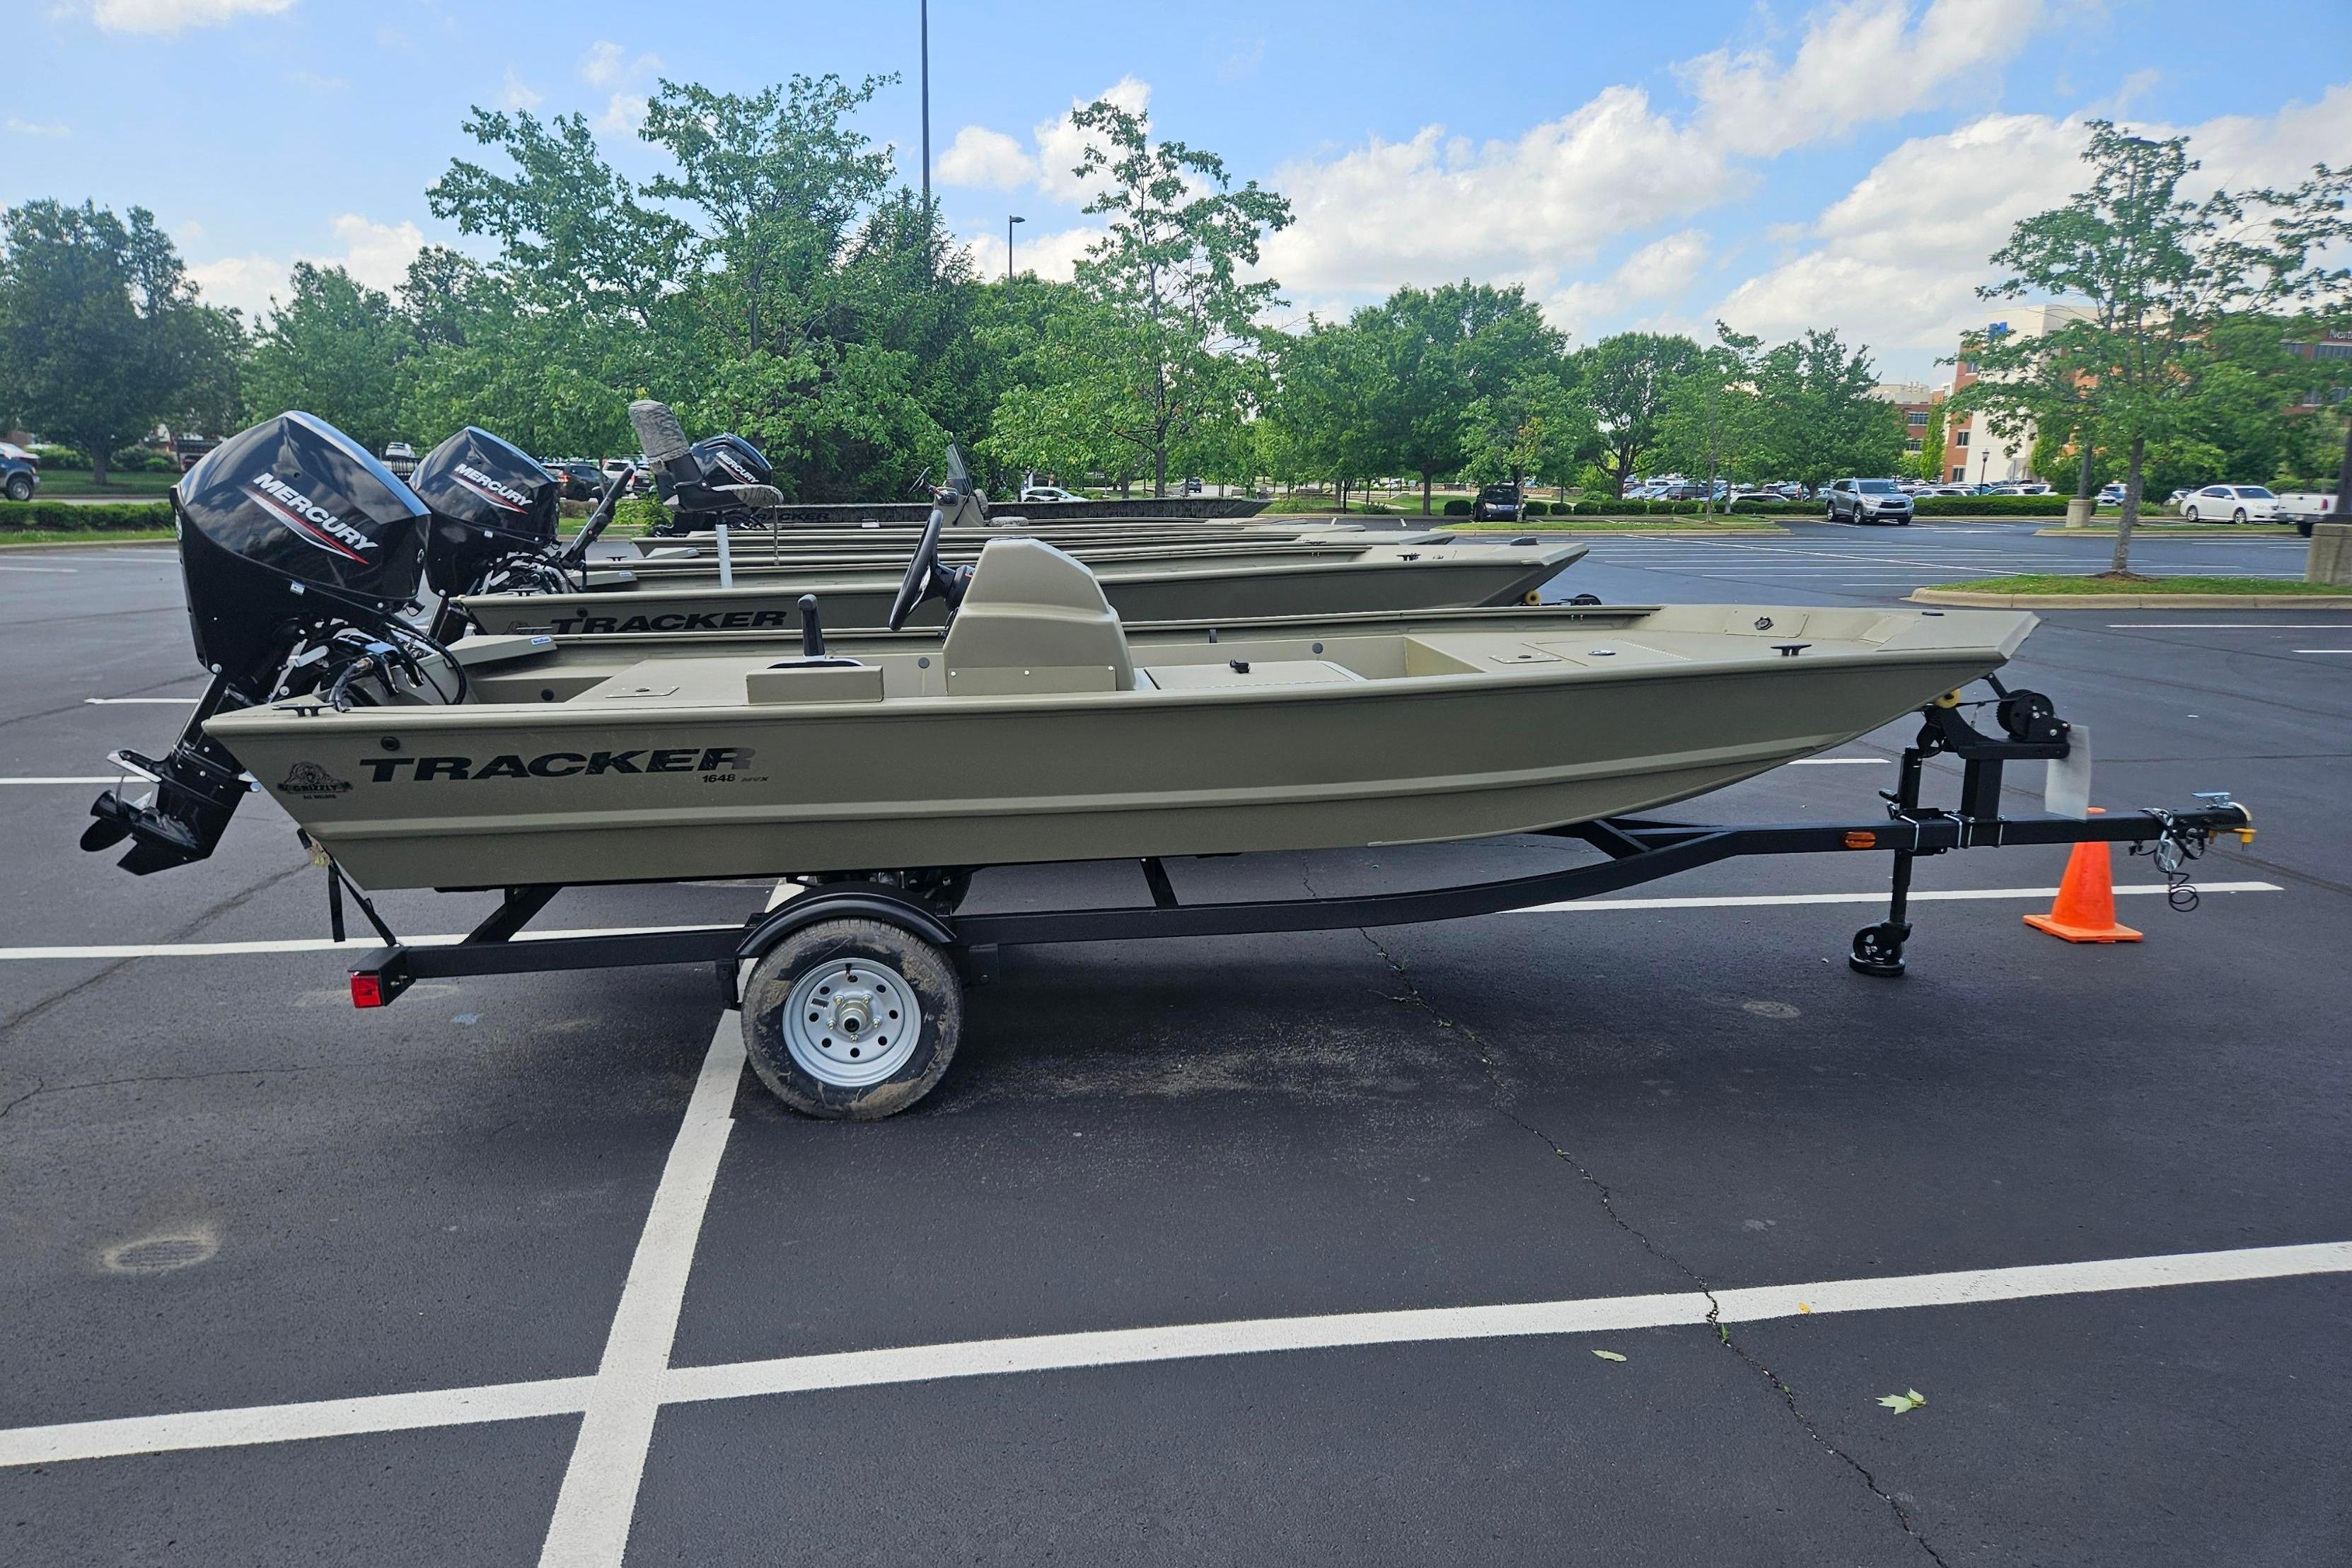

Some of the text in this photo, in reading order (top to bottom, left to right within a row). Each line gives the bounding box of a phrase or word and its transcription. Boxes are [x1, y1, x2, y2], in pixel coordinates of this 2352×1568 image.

[716, 451, 760, 483] MERCURY
[453, 463, 533, 506] MERCURY
[253, 472, 379, 550] MERCURY
[755, 512, 830, 523] RACKER
[550, 610, 787, 634] TRACKER
[359, 747, 756, 783] TRACKER
[702, 774, 736, 783] 1648
